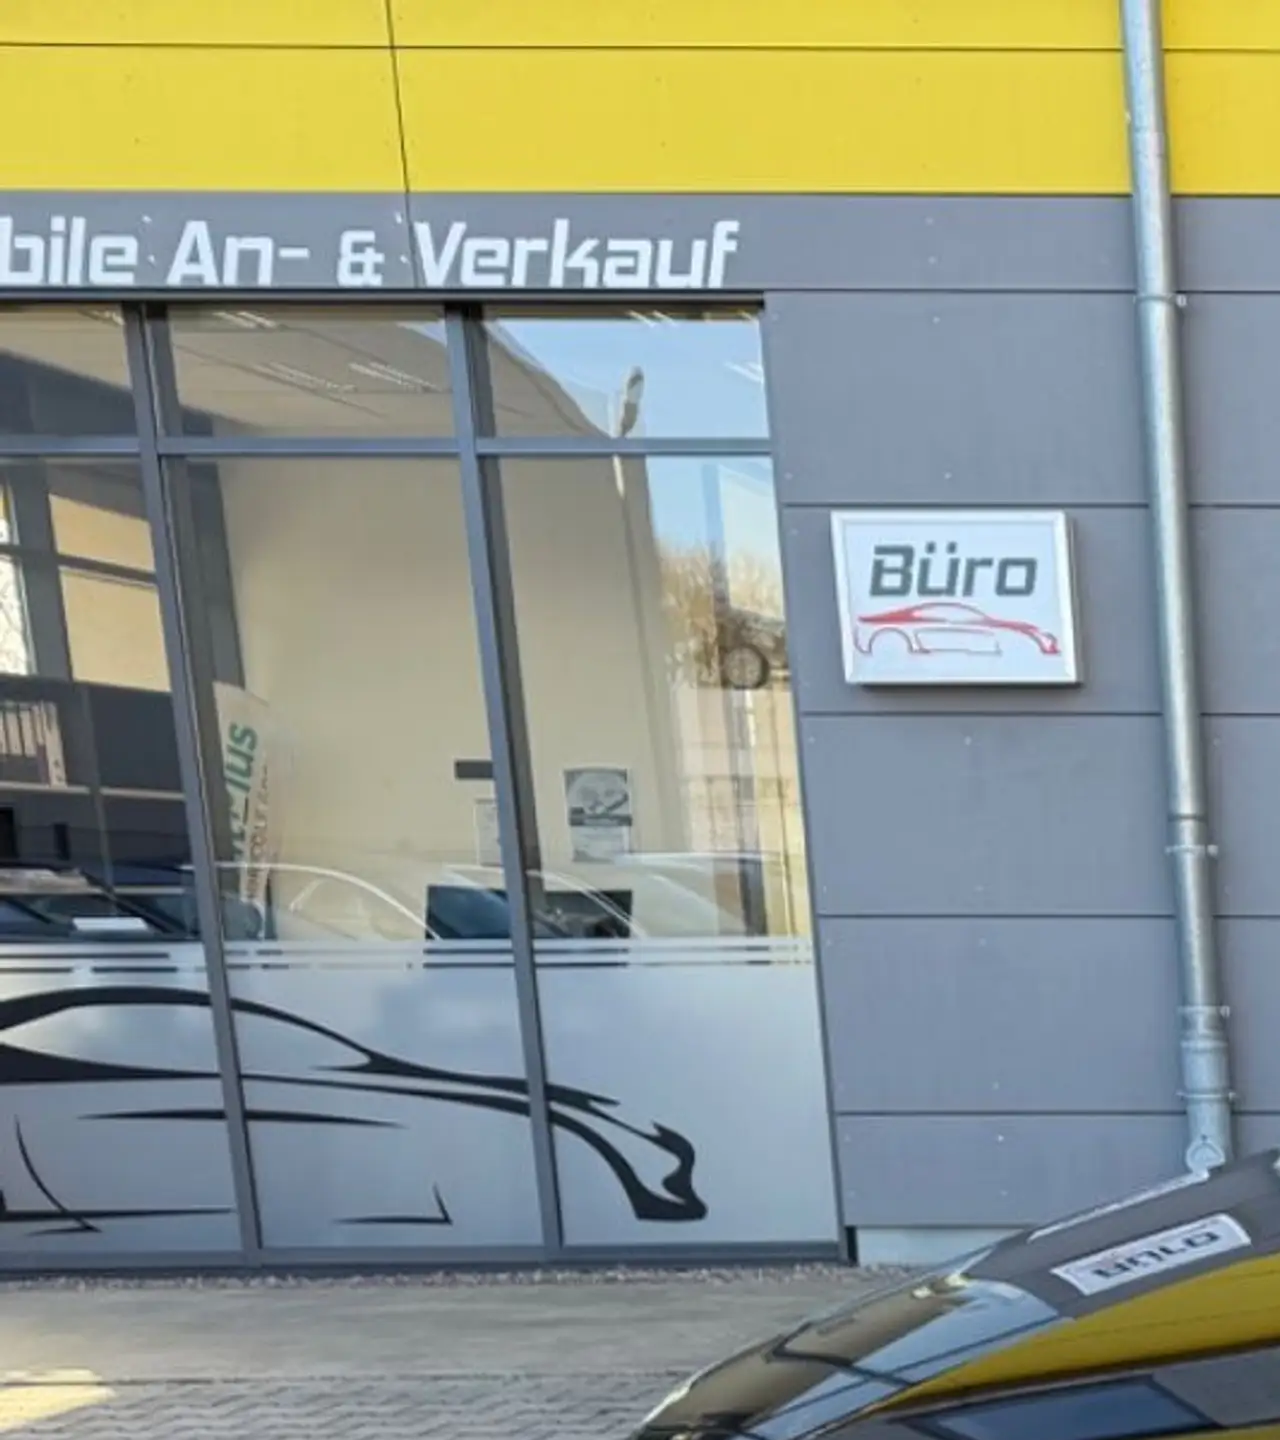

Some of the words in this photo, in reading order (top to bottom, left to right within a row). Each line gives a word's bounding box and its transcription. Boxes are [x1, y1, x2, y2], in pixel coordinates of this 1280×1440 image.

[166, 220, 309, 286] An-
[337, 230, 384, 287] &
[414, 218, 740, 288] Verkauf
[869, 541, 1038, 597] Büro
